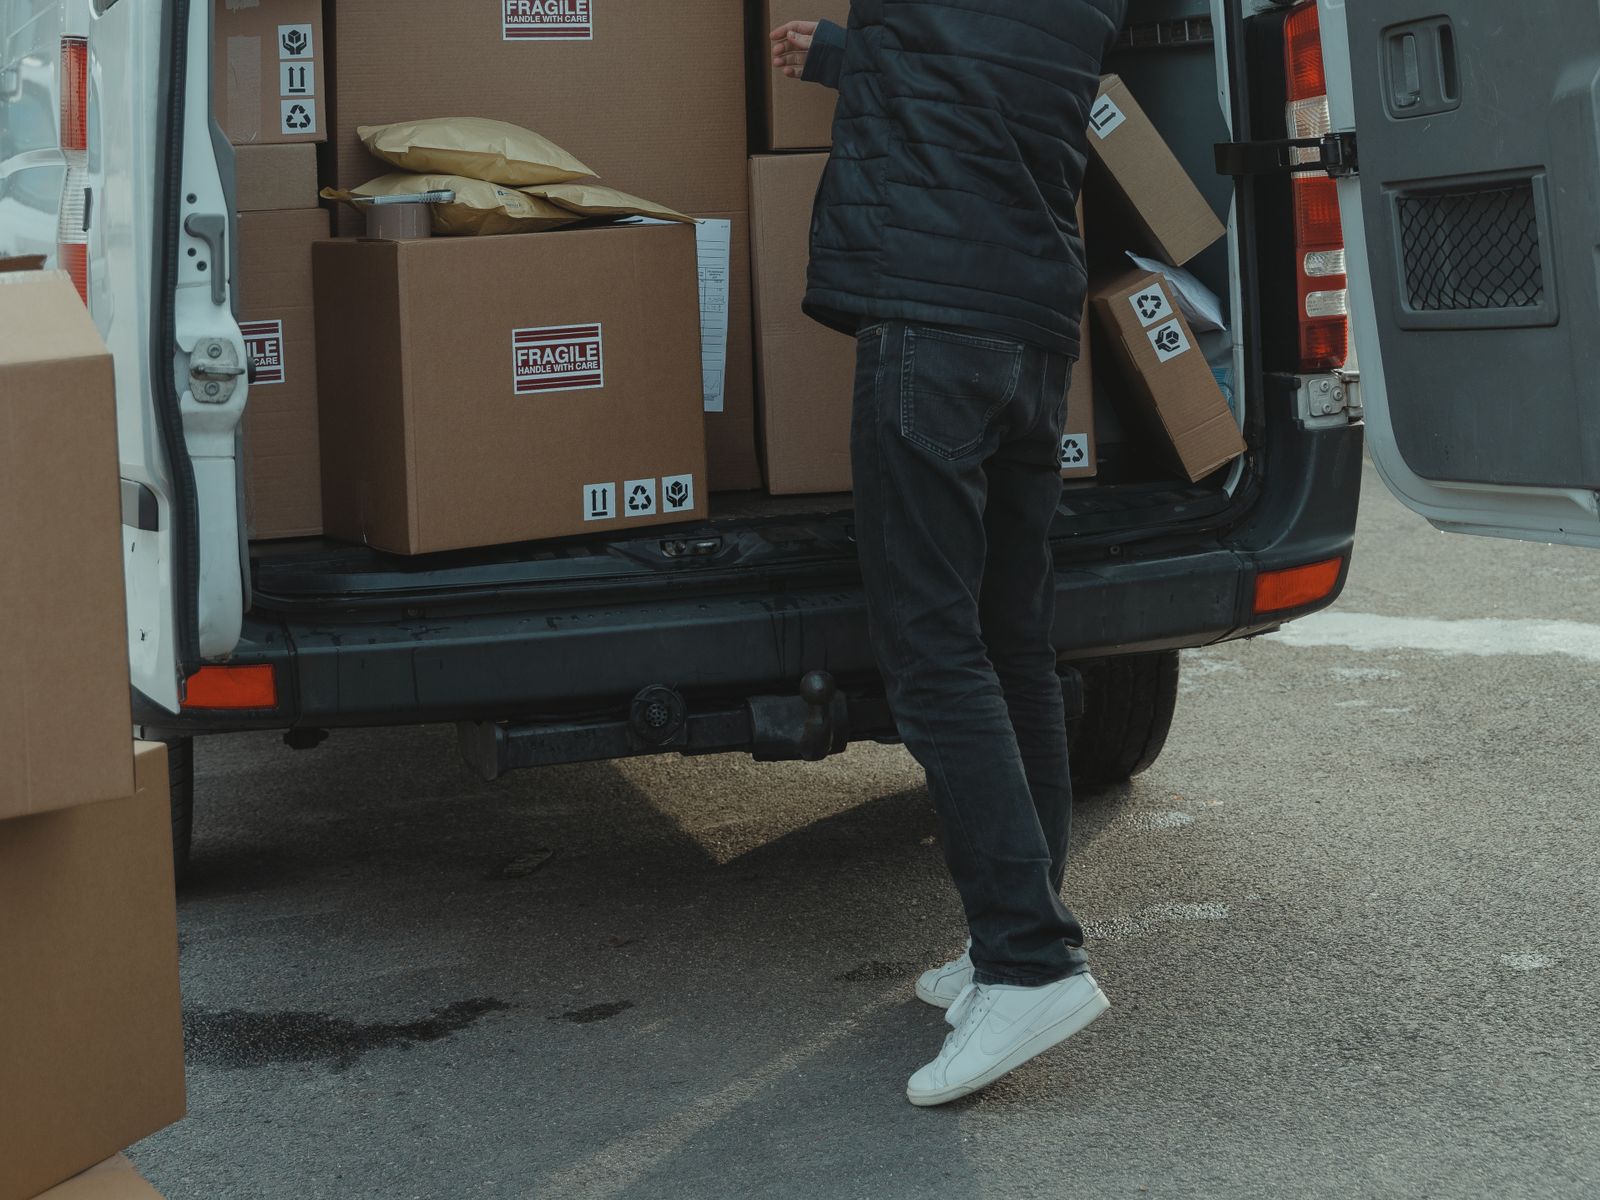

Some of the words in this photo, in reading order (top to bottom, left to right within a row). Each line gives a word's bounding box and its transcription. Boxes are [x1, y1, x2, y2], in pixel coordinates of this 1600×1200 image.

[506, 0, 588, 15] FRAGILE
[507, 15, 541, 23] HANDLE
[542, 15, 564, 23] WITH
[565, 15, 588, 23] CARE
[517, 344, 598, 366] FRAGILE
[518, 364, 551, 374] HANDLE
[553, 363, 574, 373] WITH
[575, 361, 598, 370] CARE
